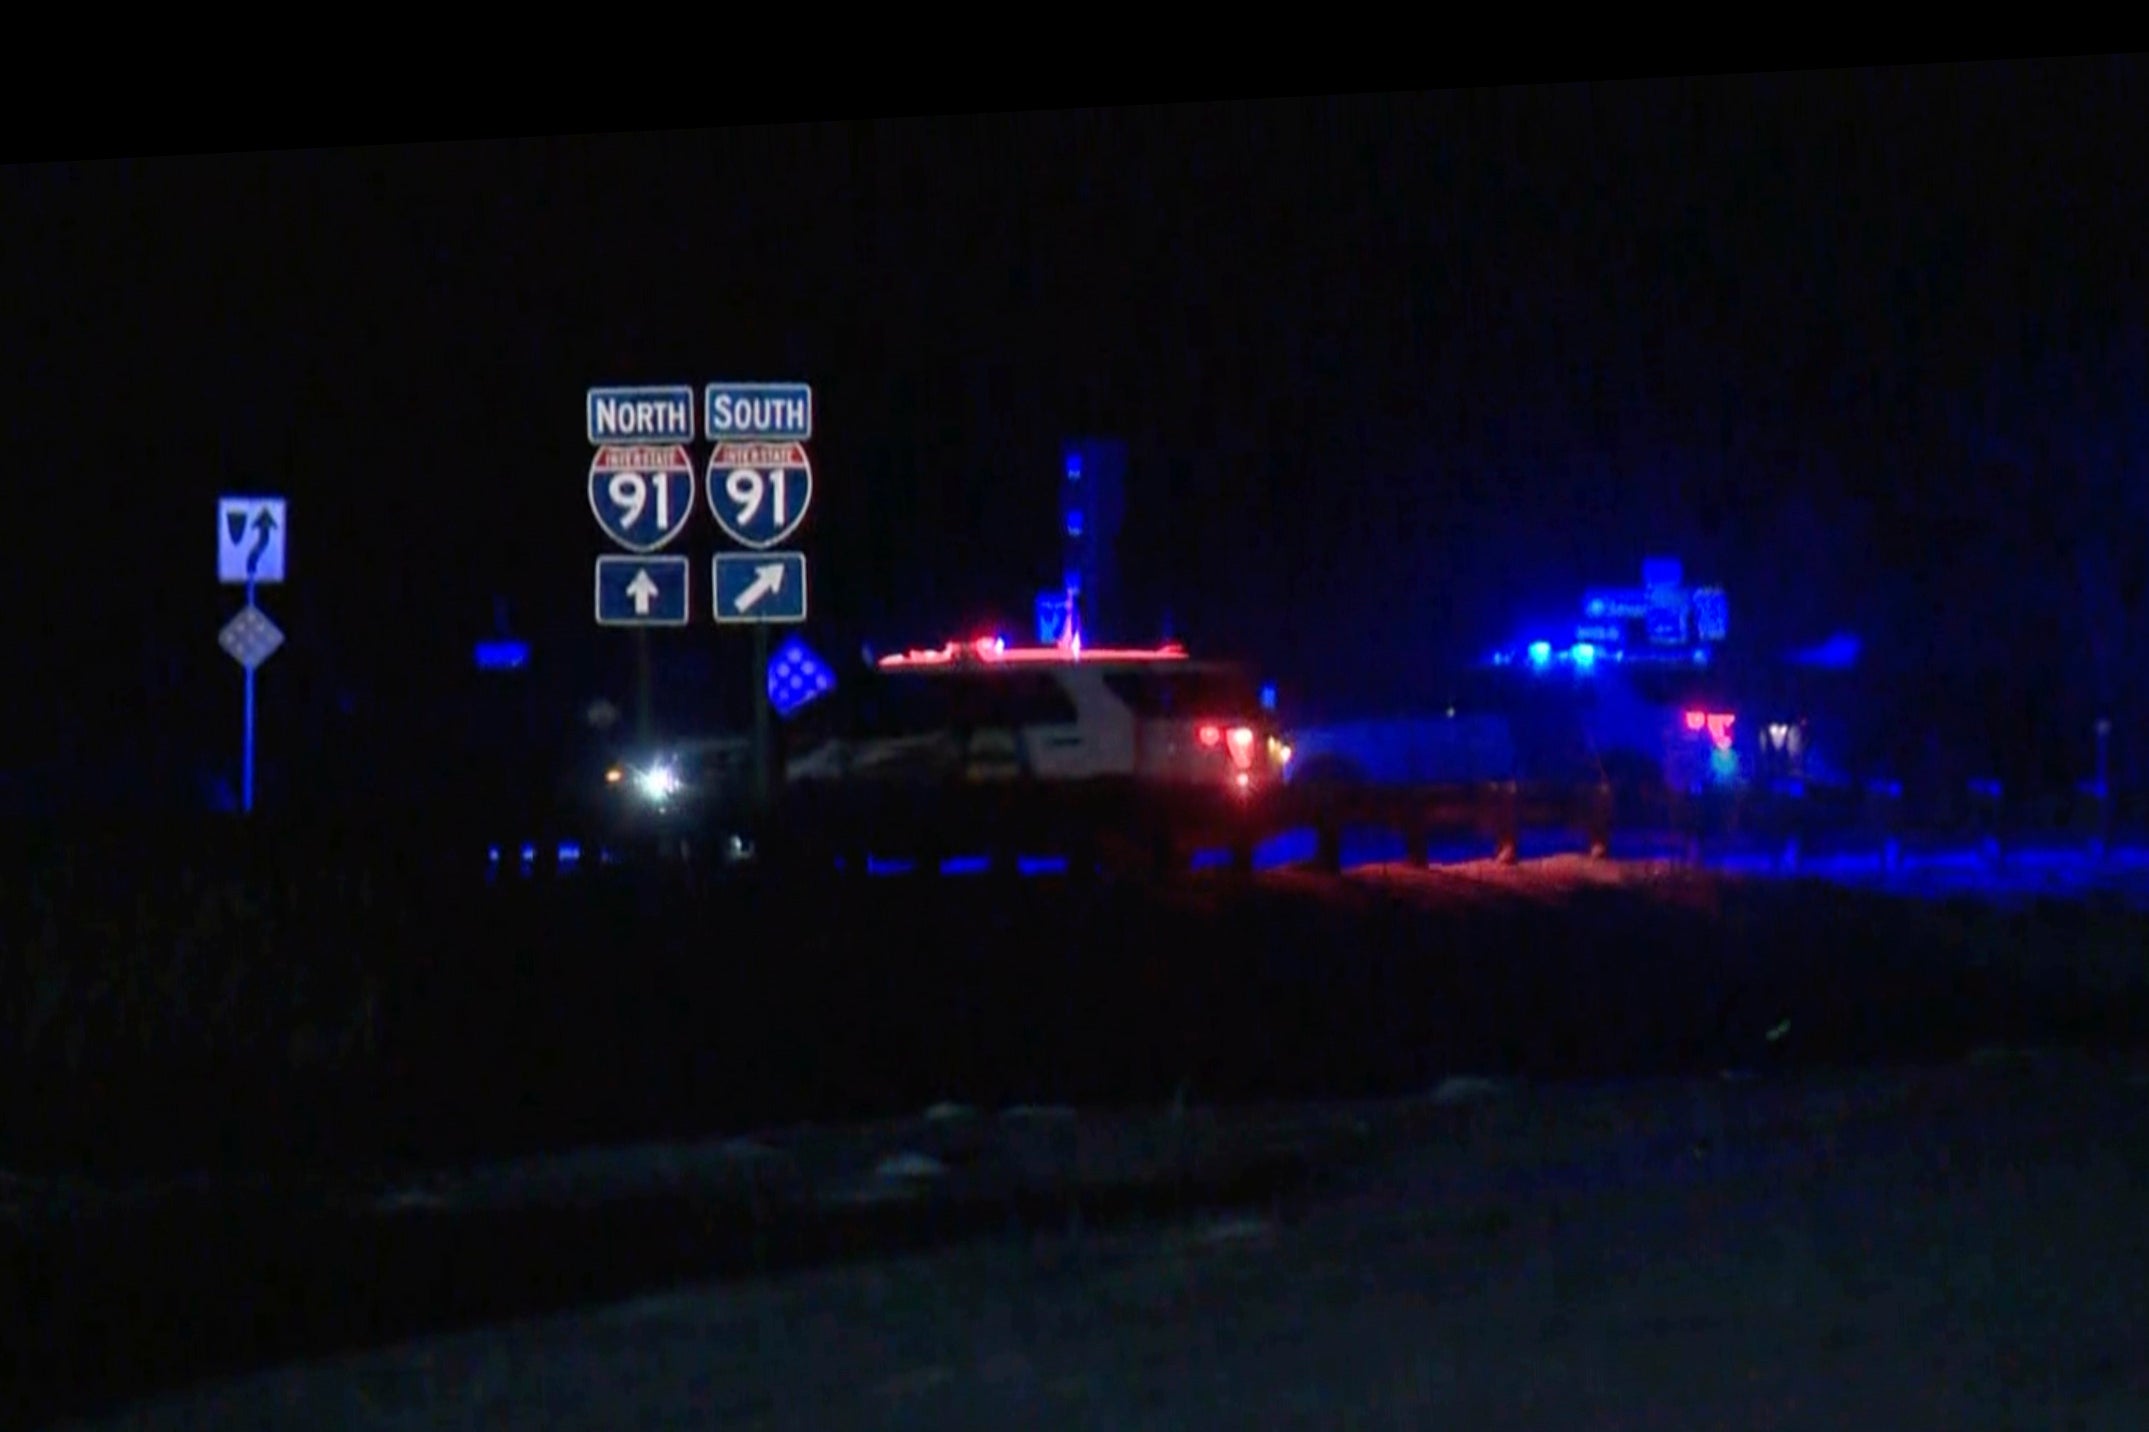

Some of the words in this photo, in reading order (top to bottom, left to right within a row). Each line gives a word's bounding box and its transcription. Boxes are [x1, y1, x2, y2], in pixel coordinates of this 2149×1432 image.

[596, 397, 686, 433] NORTH
[714, 394, 804, 430] SOUTH
[606, 448, 675, 467] INTERSTATE
[723, 446, 792, 464] INTERSTATE
[609, 472, 668, 530] 91
[726, 468, 785, 526] 91
